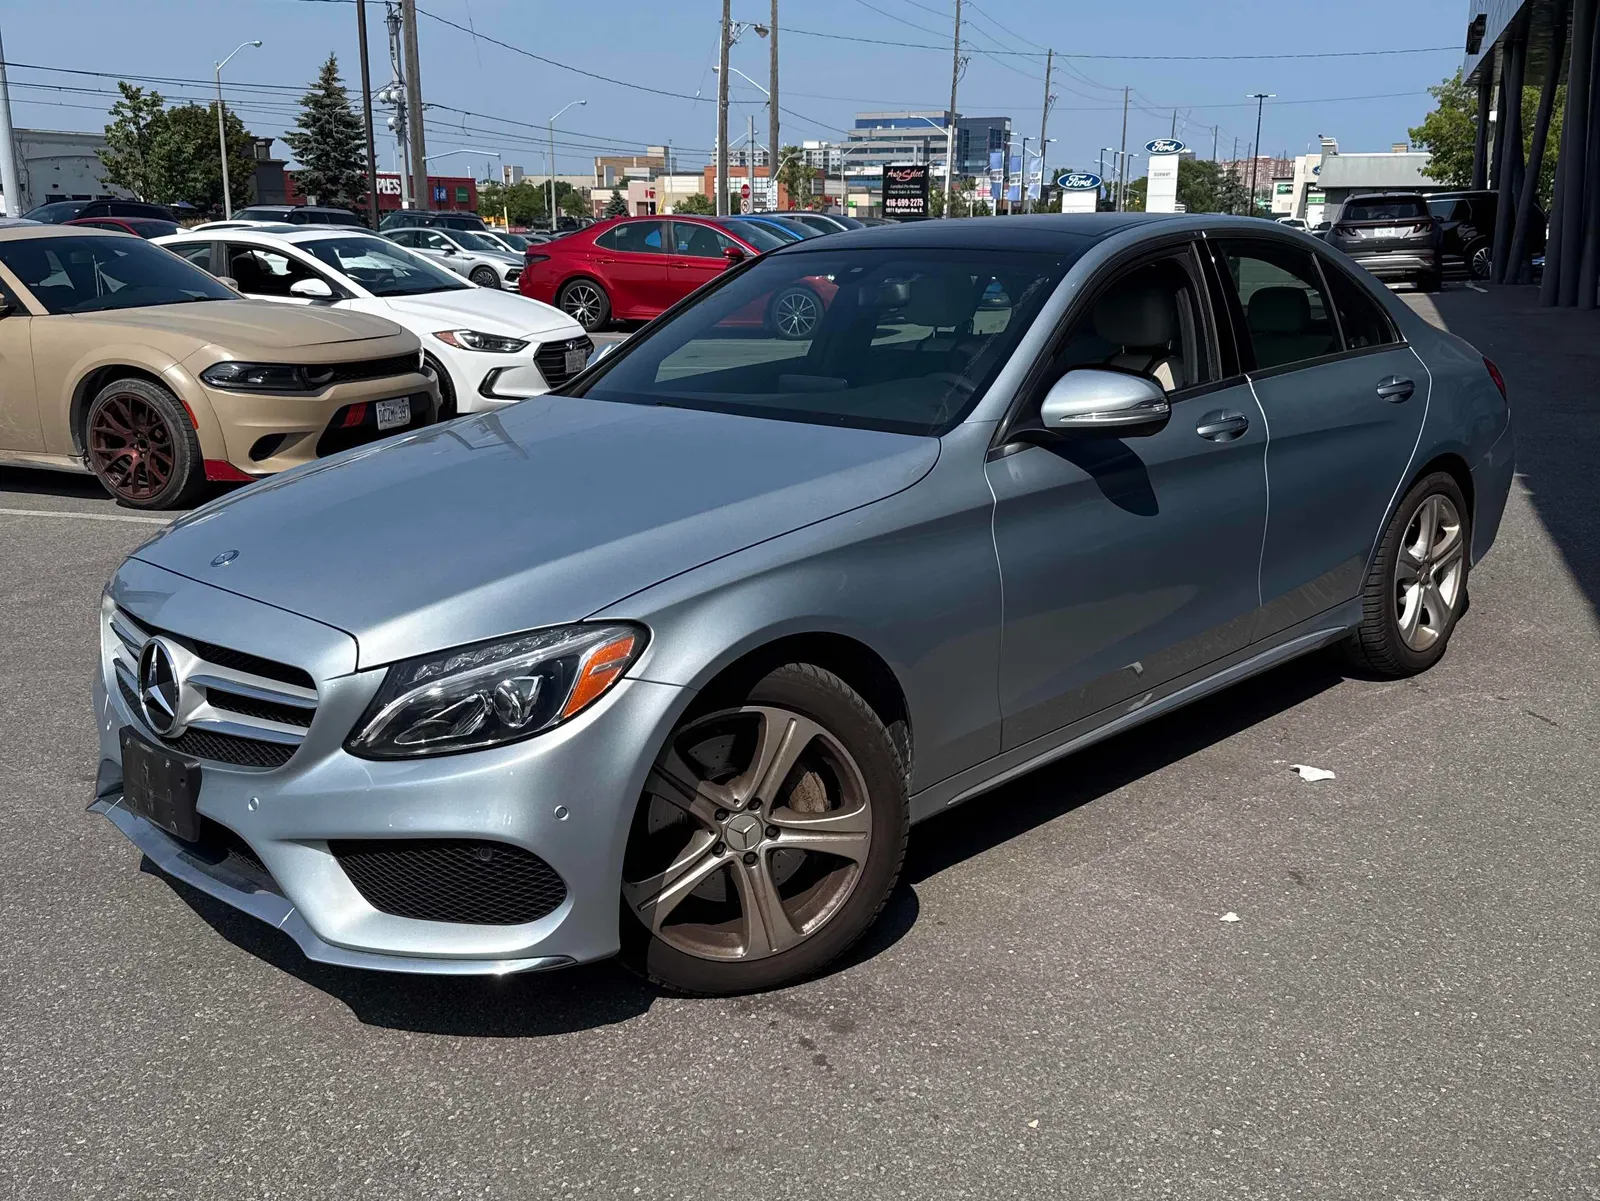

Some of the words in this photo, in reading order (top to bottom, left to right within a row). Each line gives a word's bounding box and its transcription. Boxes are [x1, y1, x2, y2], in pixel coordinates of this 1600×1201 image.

[1151, 140, 1176, 152] Ford
[376, 178, 401, 194] PLES
[1065, 175, 1092, 187] Ford
